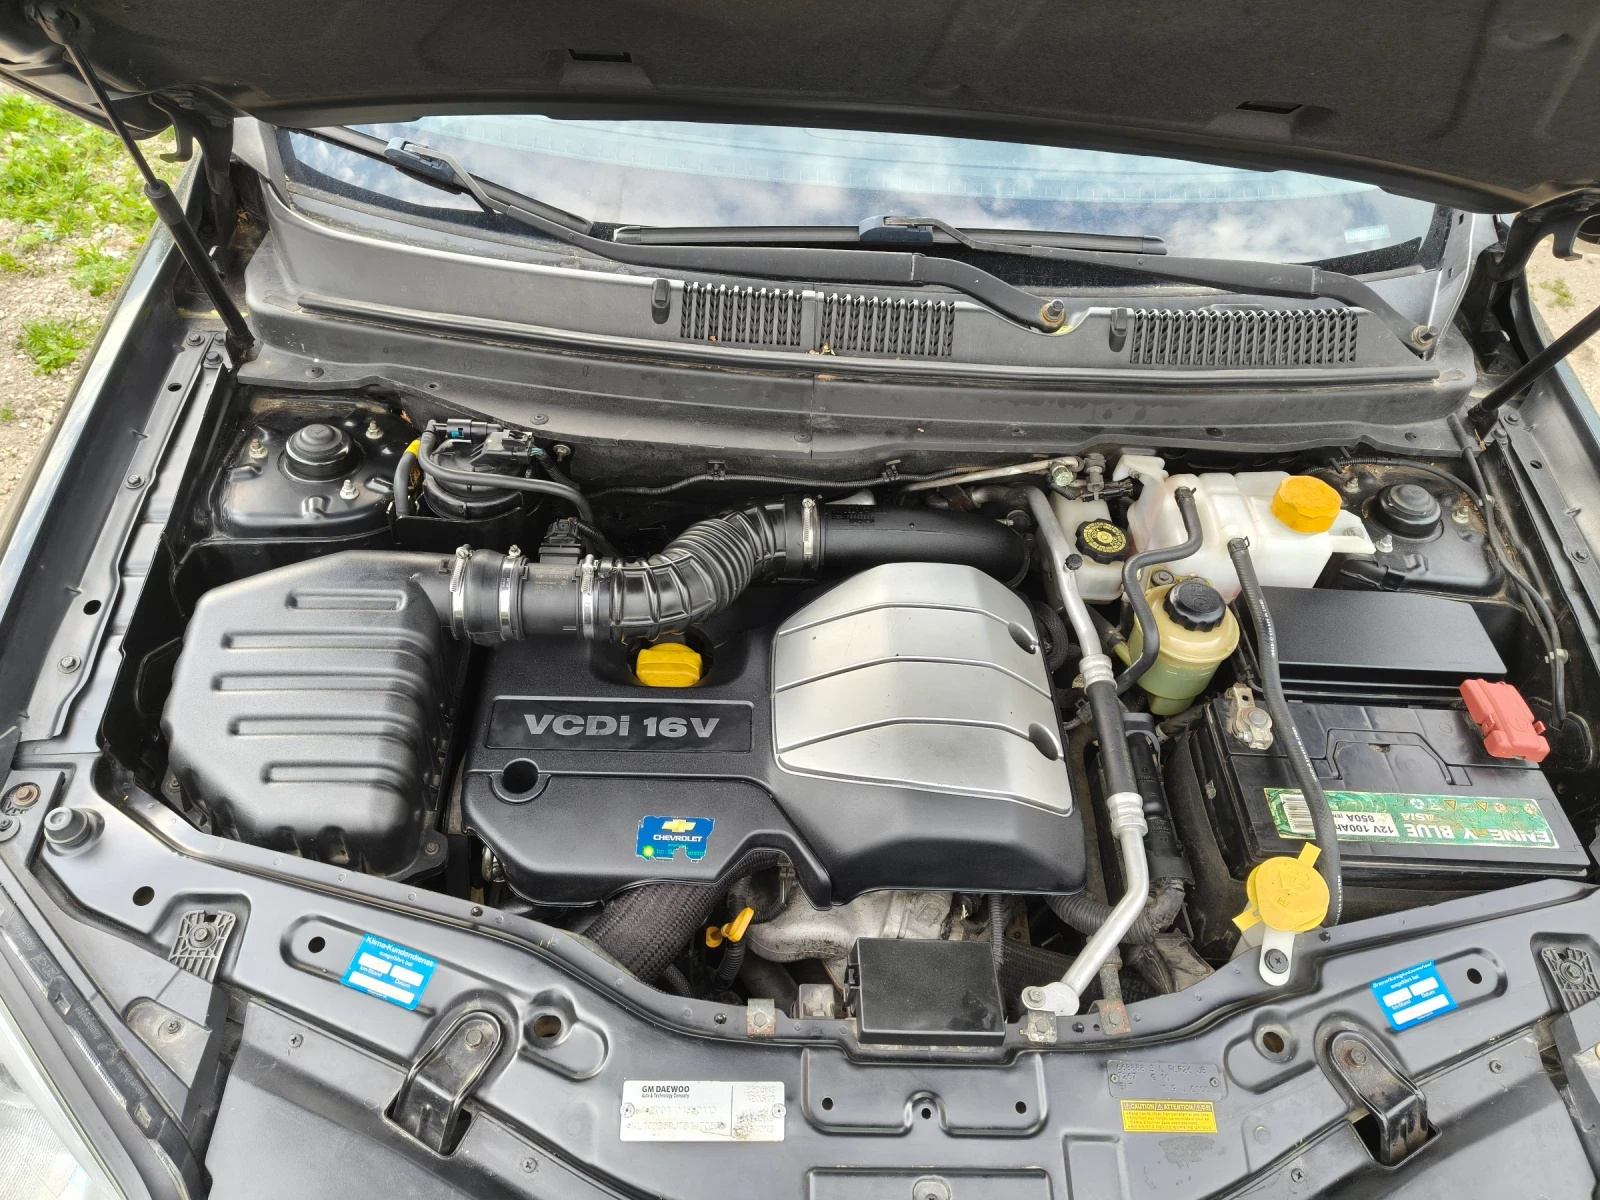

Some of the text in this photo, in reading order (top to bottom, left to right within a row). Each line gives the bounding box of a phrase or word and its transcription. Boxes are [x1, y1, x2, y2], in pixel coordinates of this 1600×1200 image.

[524, 714, 720, 738] VCDi 16V
[1345, 813, 1375, 822] 850A
[1400, 812, 1435, 822] ASIA
[1373, 824, 1394, 834] 12V
[1408, 823, 1455, 839] BLUE
[653, 834, 703, 842] CHEVROLET
[366, 935, 435, 967] Klima-Kundendienst
[641, 1085, 690, 1093] GM DAEWOO
